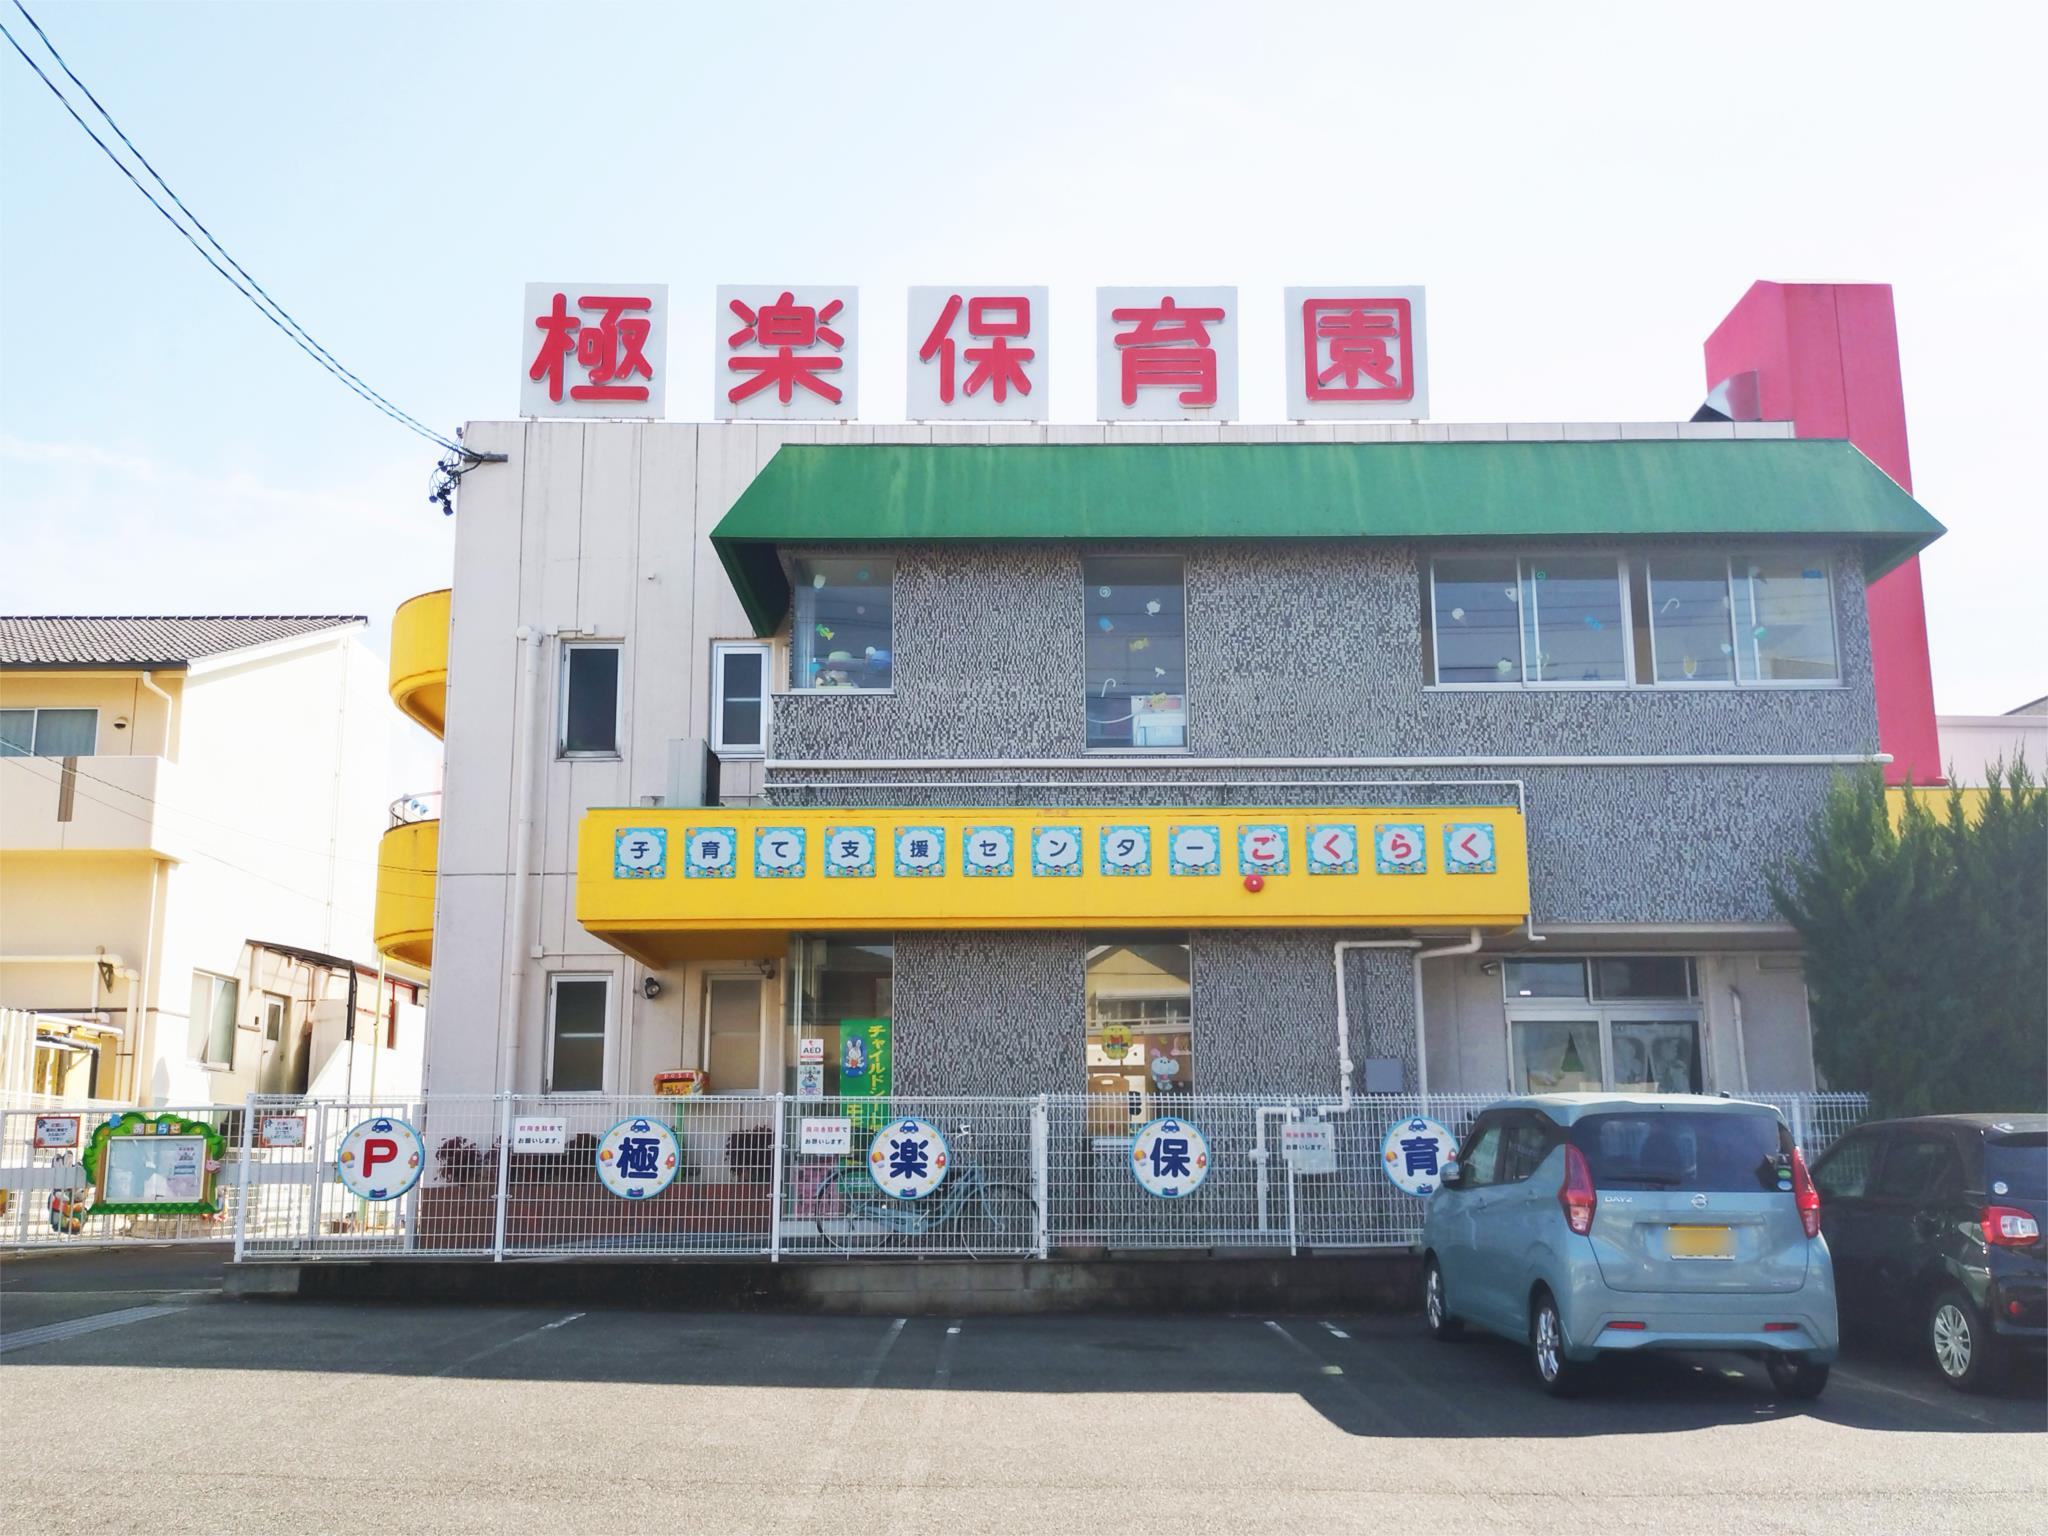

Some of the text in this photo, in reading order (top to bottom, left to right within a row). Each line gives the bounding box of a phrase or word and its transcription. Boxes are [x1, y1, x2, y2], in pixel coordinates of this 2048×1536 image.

[529, 291, 1413, 406] 極楽保育園
[363, 1139, 398, 1178] P
[616, 1137, 661, 1179] 極
[890, 1138, 929, 1179] 楽
[1149, 1137, 1191, 1178] 保
[1400, 1136, 1439, 1177] 育
